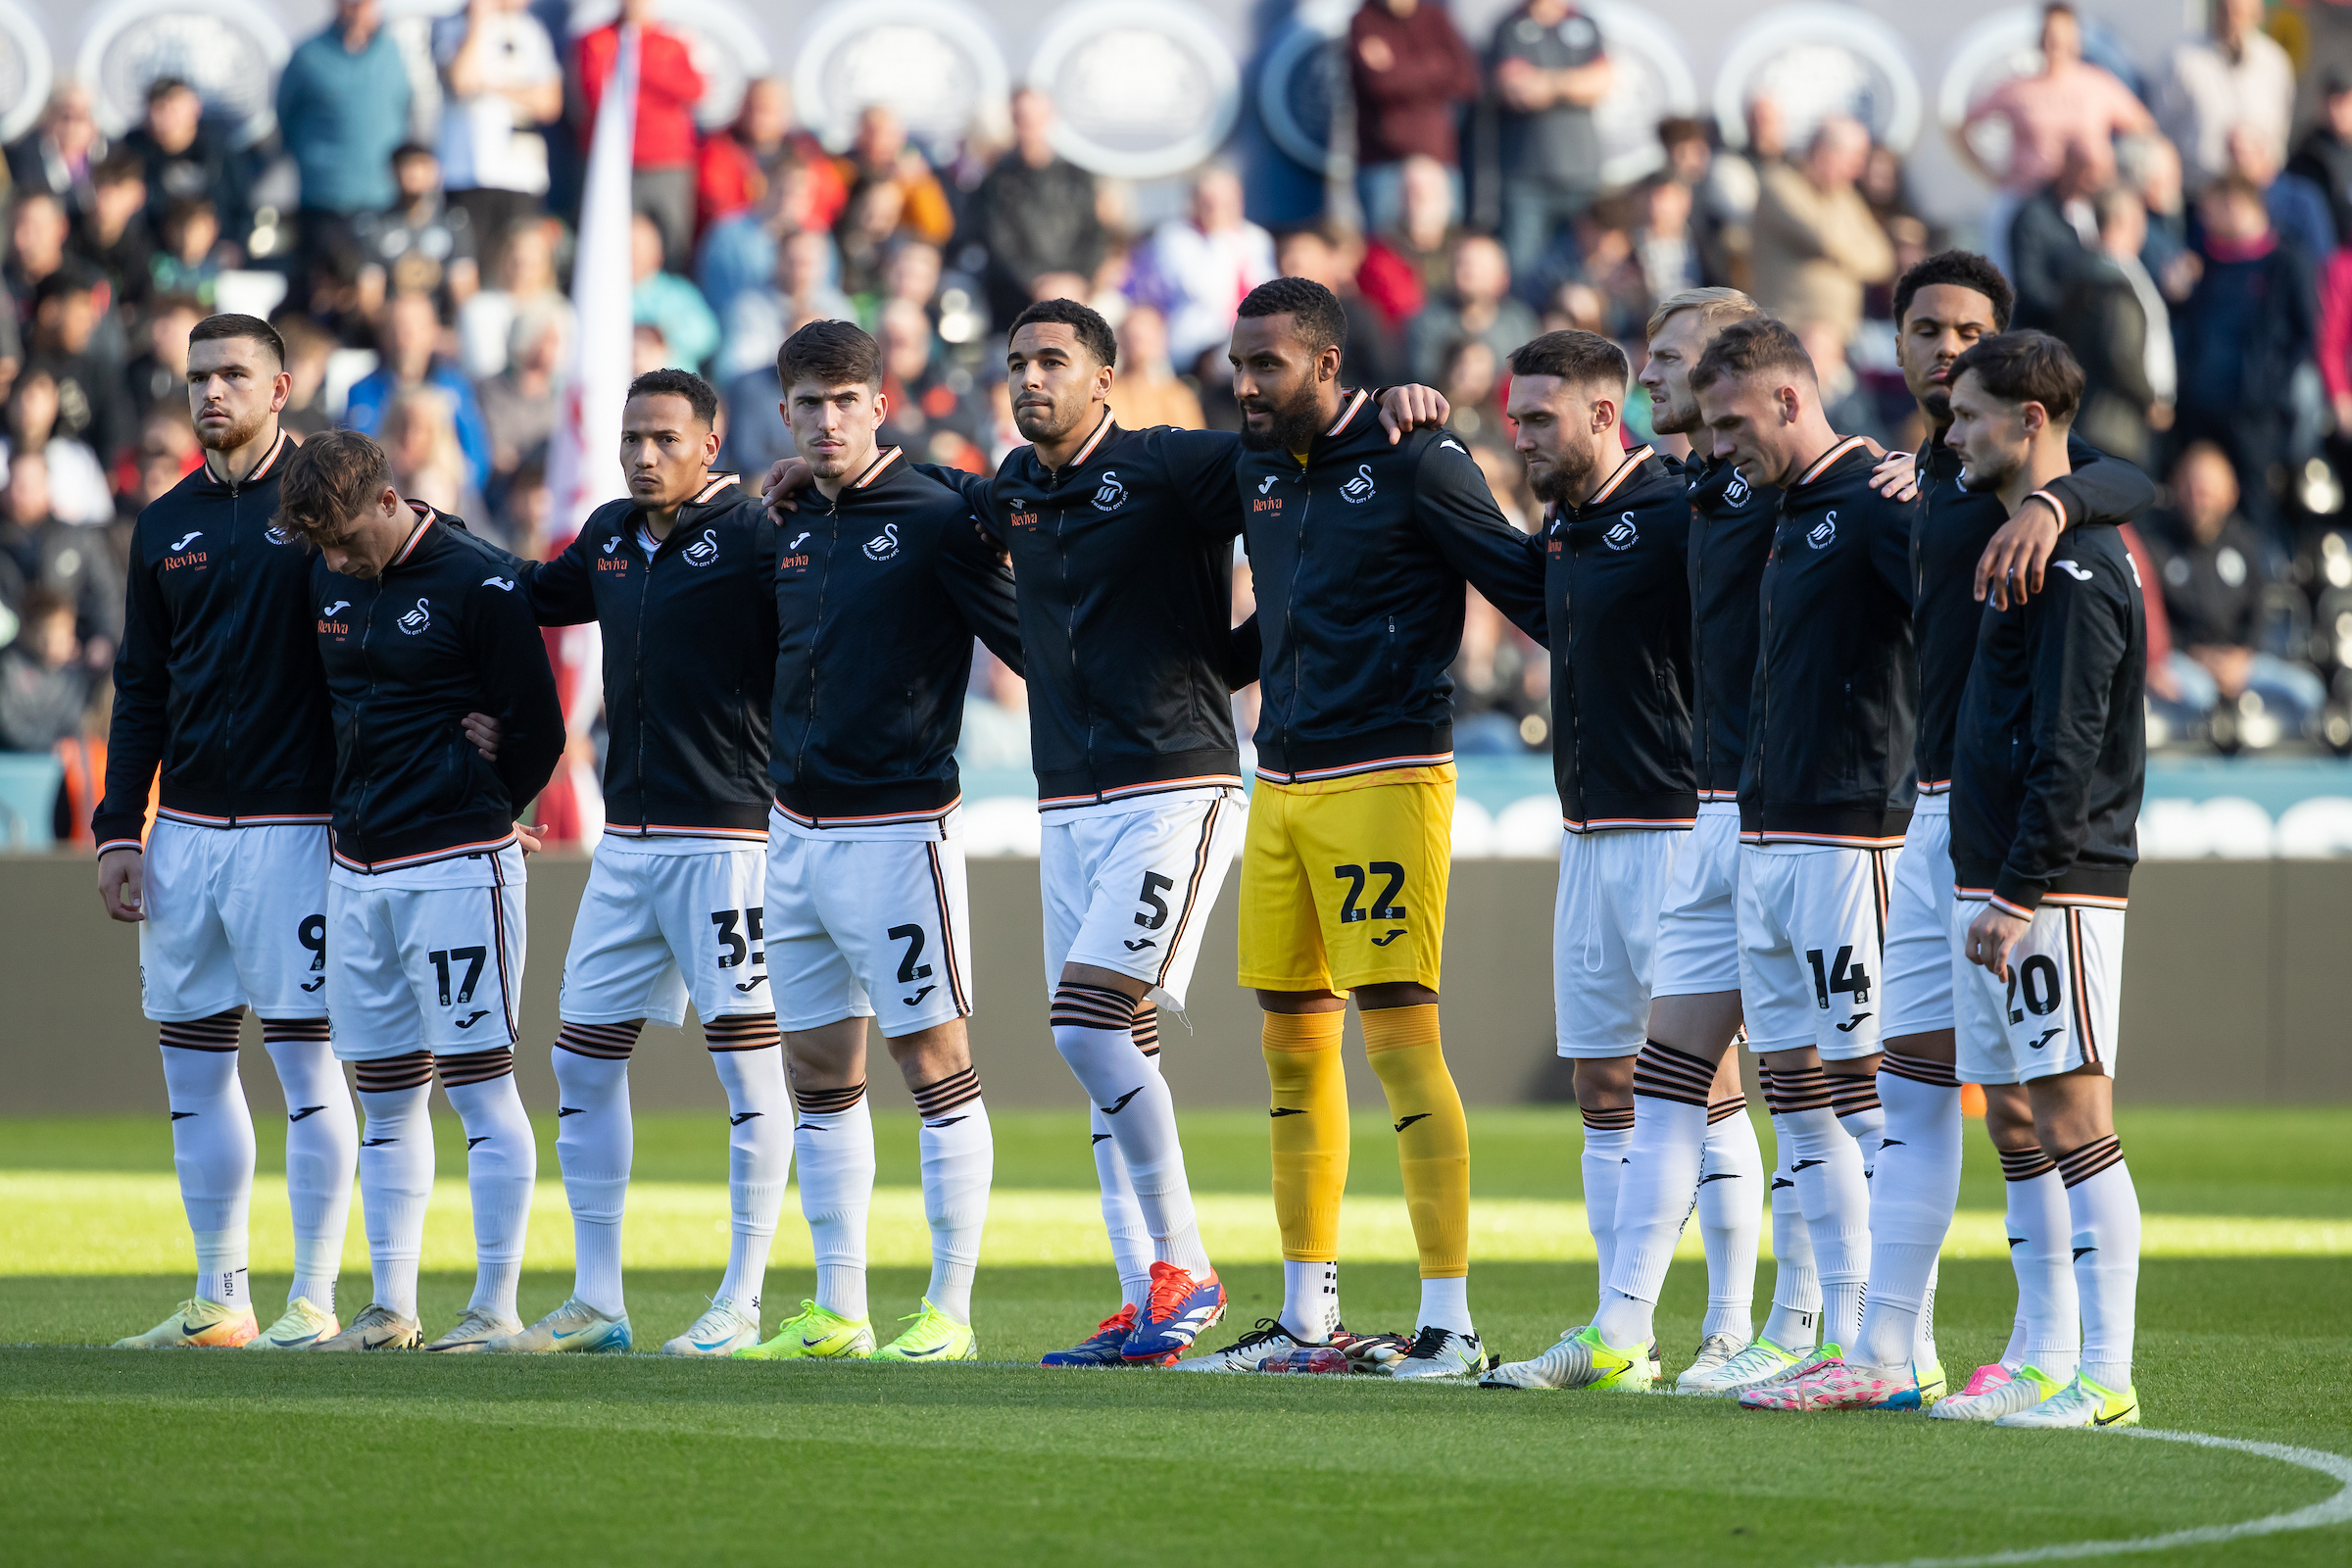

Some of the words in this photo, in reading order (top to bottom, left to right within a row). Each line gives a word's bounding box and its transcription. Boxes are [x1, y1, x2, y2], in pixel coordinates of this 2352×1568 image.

[1091, 500, 1112, 512] SWANSEA
[1113, 500, 1123, 510] CITY
[1253, 496, 1283, 513] Reviva
[1010, 512, 1038, 527] Reviva
[682, 549, 698, 566] SWANSEA
[861, 543, 878, 561] SWANSEA
[164, 551, 208, 571] Reviva
[598, 557, 627, 571] Reviva
[780, 553, 809, 570] Reviva
[318, 619, 349, 634] Reviva
[397, 618, 412, 635] SWANSEA
[1134, 870, 1174, 930] 5
[1334, 861, 1406, 923] 22
[298, 913, 326, 971] 9
[887, 923, 933, 984] 2
[428, 946, 487, 1006] 17
[1806, 946, 1872, 1009] 14
